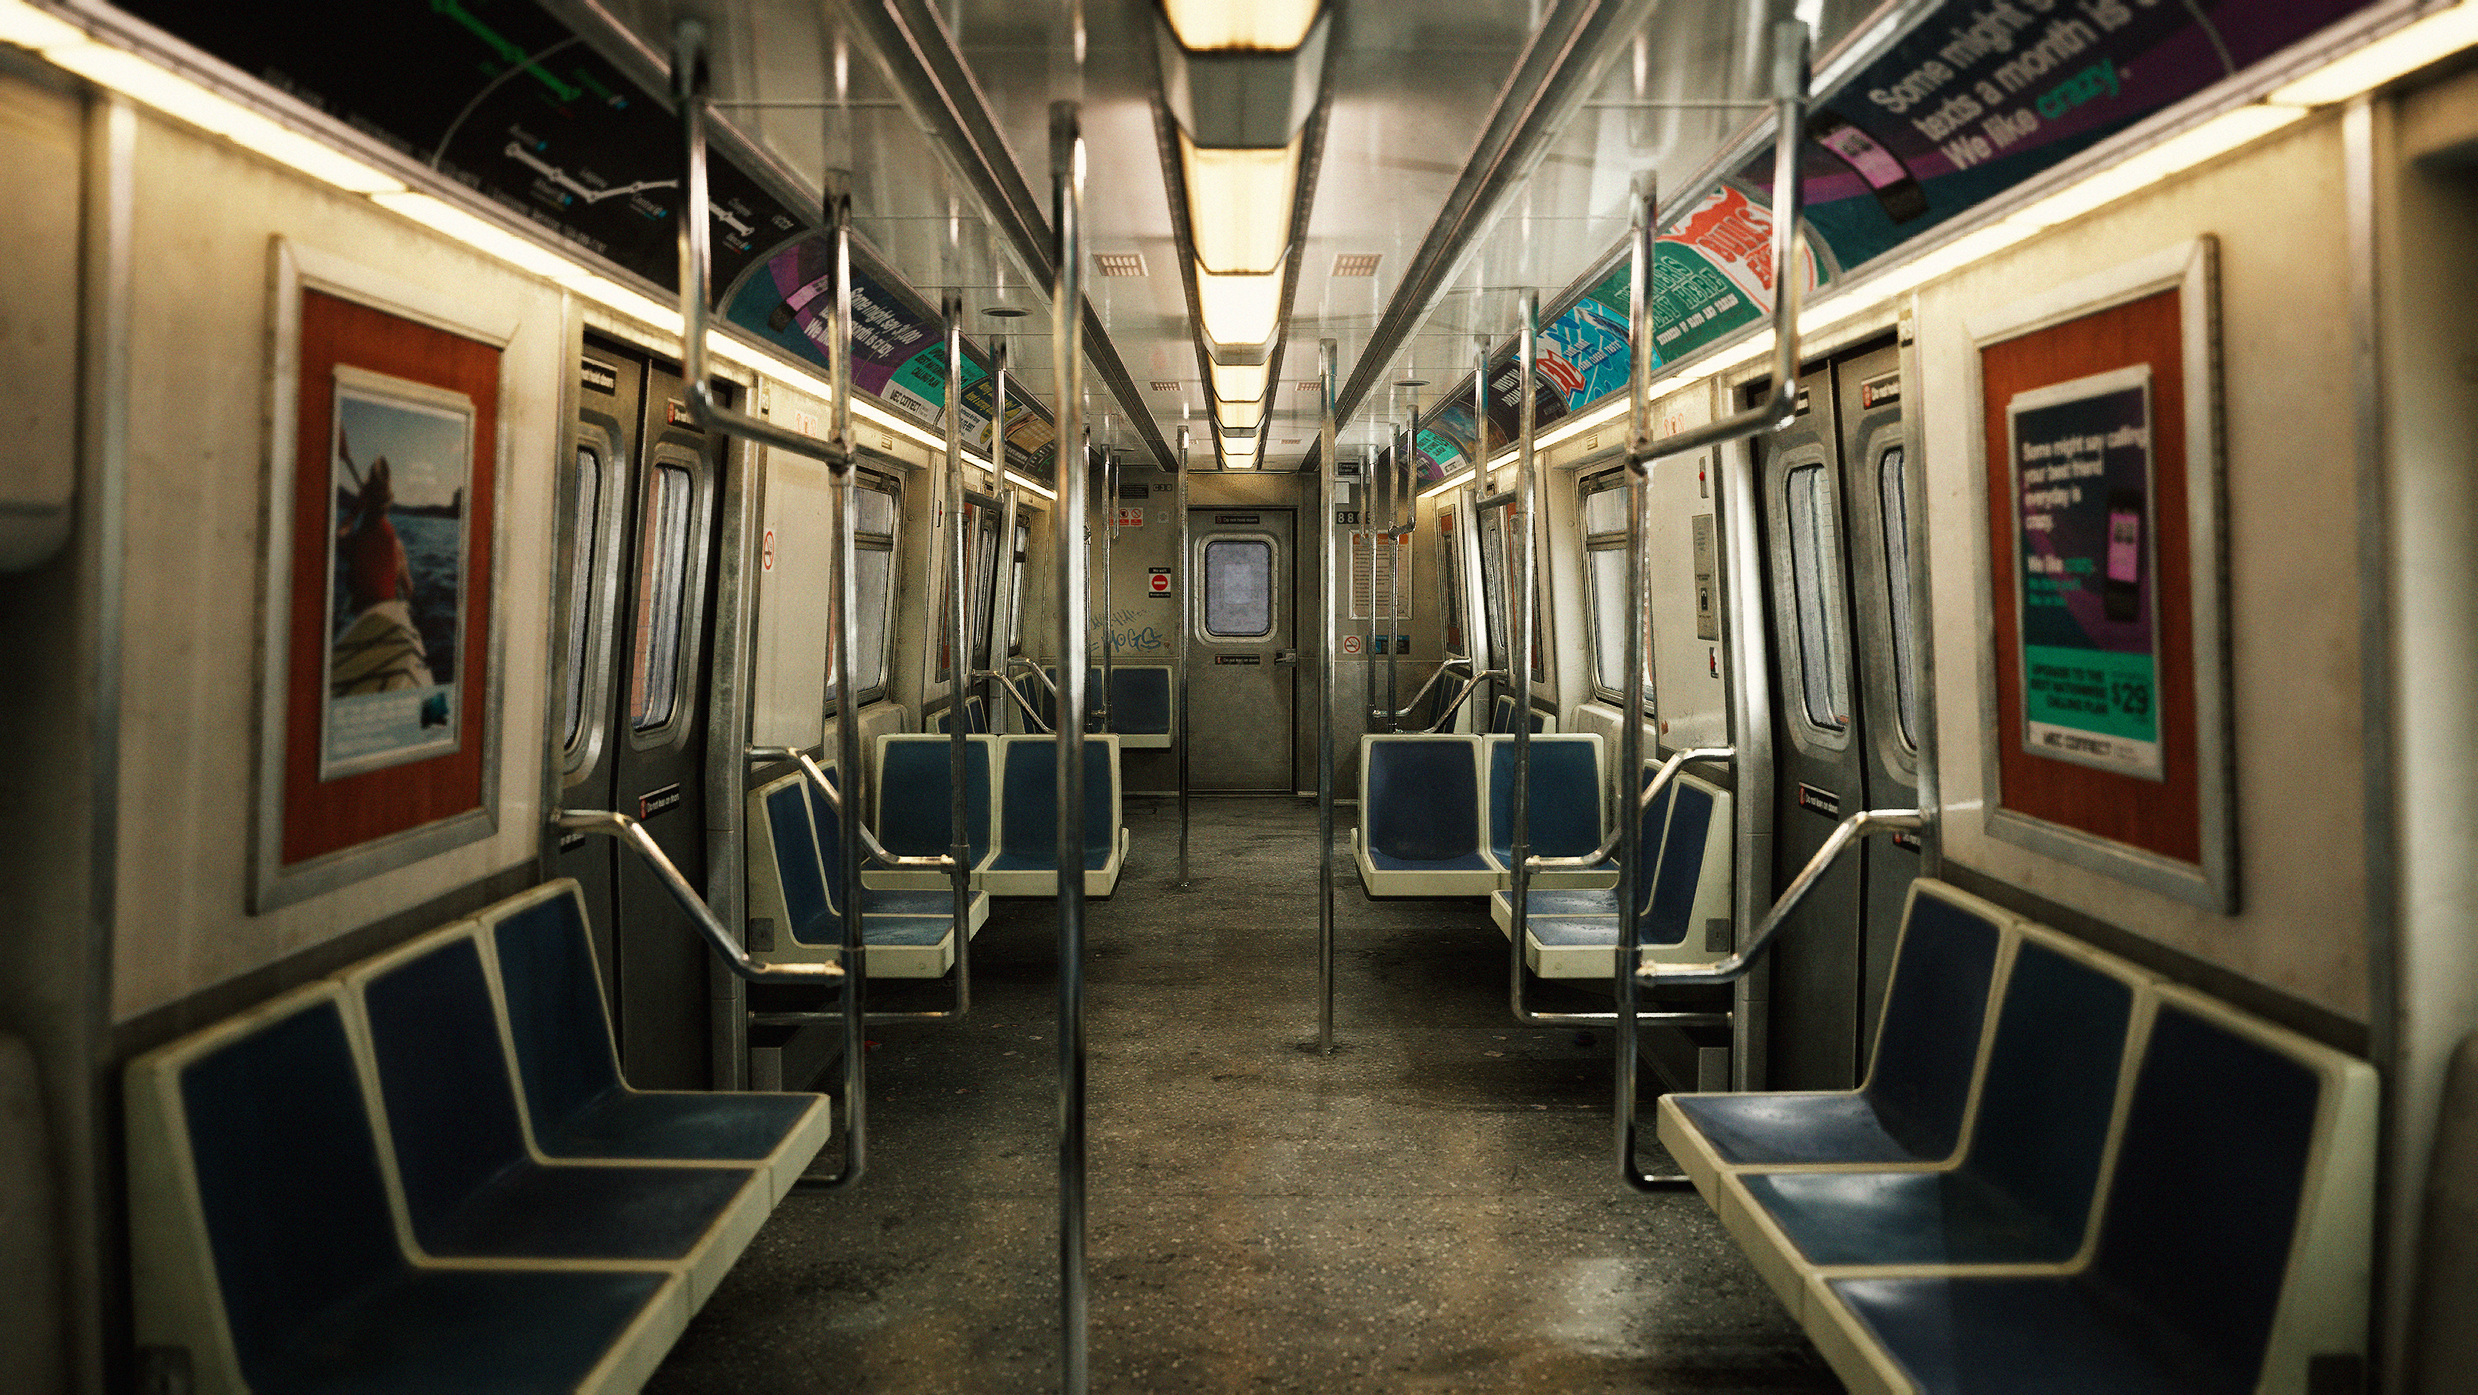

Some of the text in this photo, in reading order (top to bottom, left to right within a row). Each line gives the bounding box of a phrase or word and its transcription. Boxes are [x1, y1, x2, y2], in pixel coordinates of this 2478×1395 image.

[1868, 0, 2034, 113] Some might
[1911, 93, 1984, 143] texts
[1974, 80, 2004, 105] a
[1994, 19, 2099, 93] month
[1940, 135, 1993, 171] We
[1981, 107, 2041, 150] like
[1671, 267, 1728, 310] HERE
[2112, 682, 2149, 716] $29
